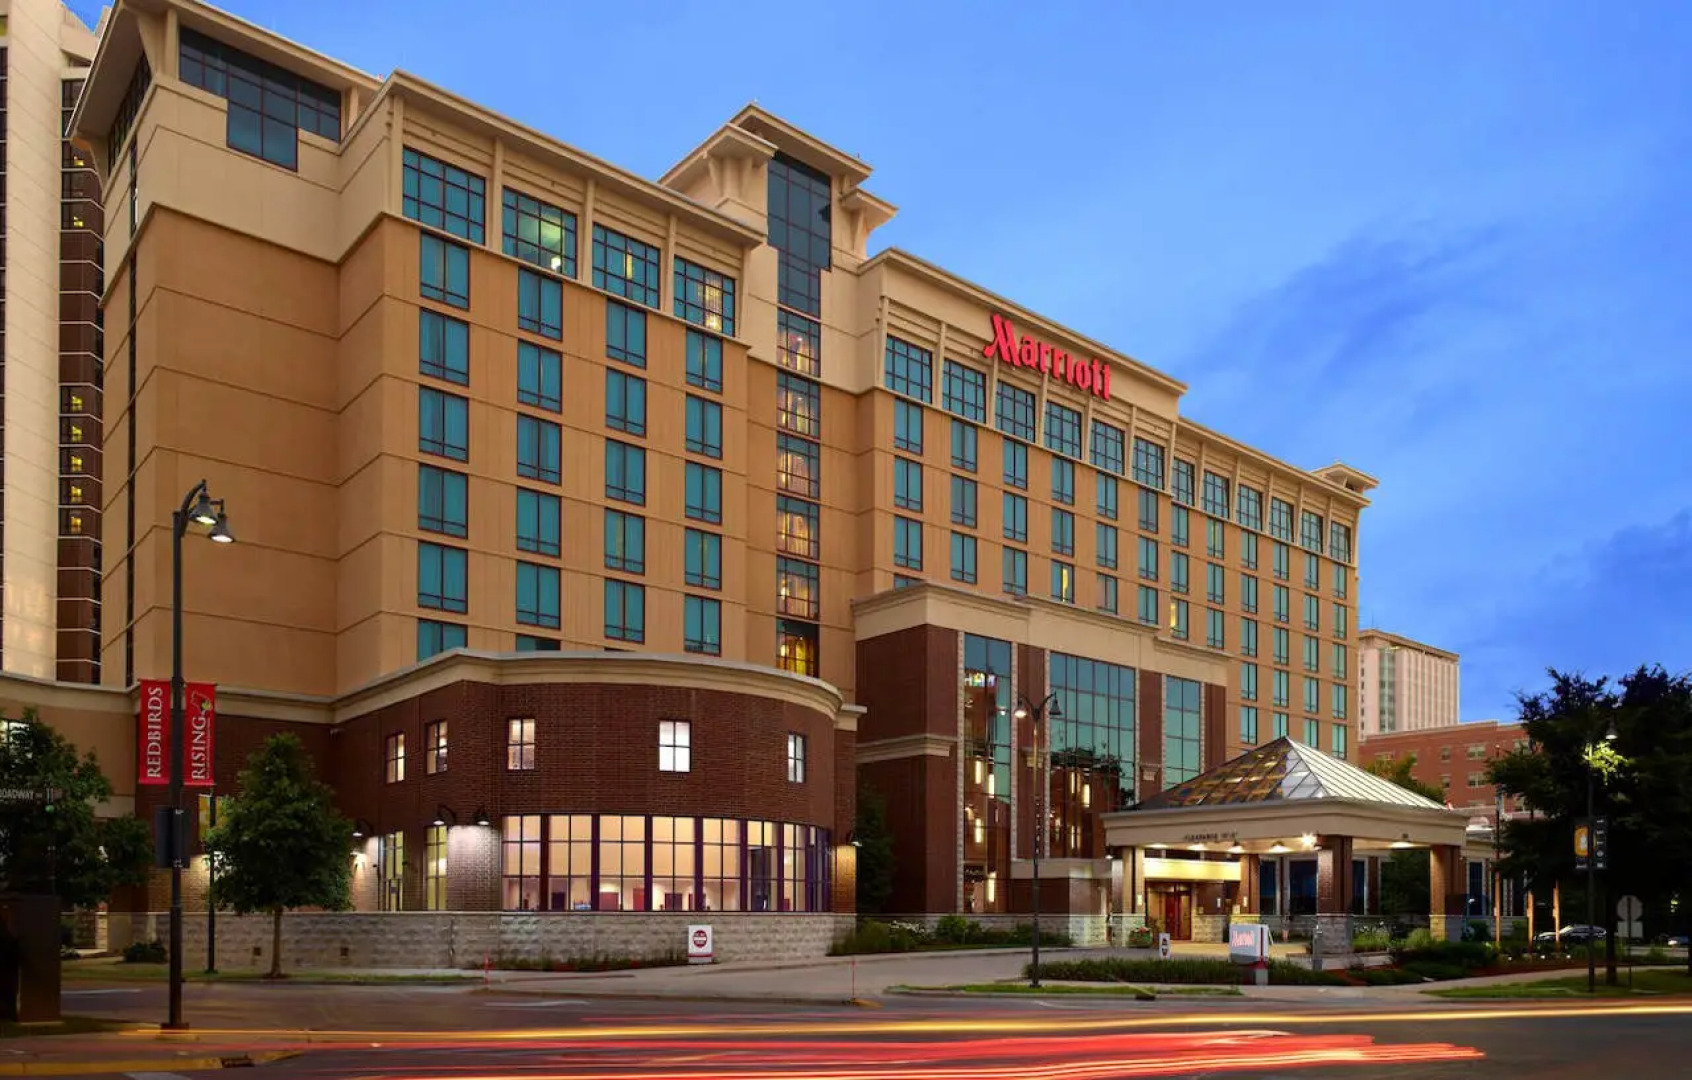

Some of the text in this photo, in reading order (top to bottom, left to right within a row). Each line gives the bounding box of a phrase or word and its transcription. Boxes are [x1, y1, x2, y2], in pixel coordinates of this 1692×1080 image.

[983, 314, 1111, 402] Marriott
[147, 687, 163, 778] REDBIRDS
[192, 717, 206, 780] RISING
[0, 788, 34, 800] OADWAY
